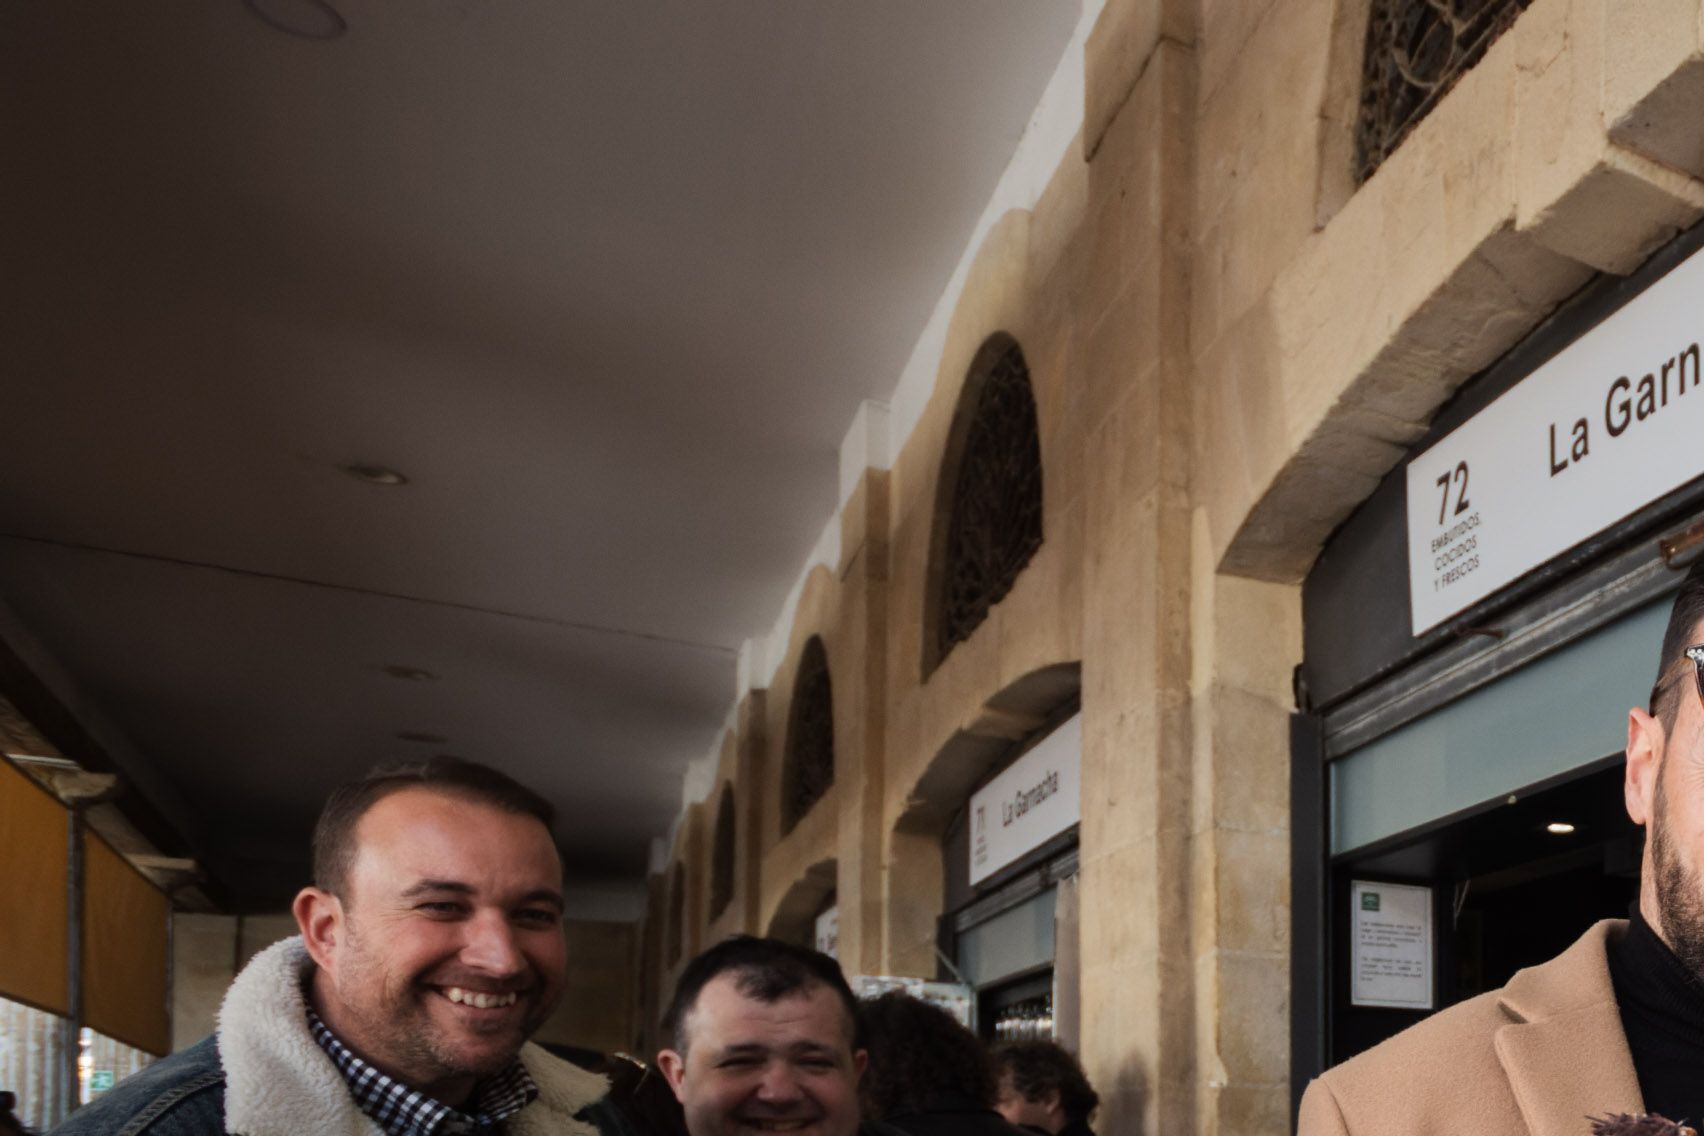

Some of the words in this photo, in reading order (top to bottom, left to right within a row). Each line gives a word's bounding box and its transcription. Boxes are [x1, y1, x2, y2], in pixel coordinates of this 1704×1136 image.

[1549, 416, 1591, 479] La
[1436, 460, 1470, 526] 72
[1434, 578, 1440, 592] Y
[1442, 554, 1480, 588] FRESCOS
[1435, 534, 1477, 571] COCIDOS
[1001, 800, 1013, 828] La
[1014, 770, 1059, 819] Garnacha
